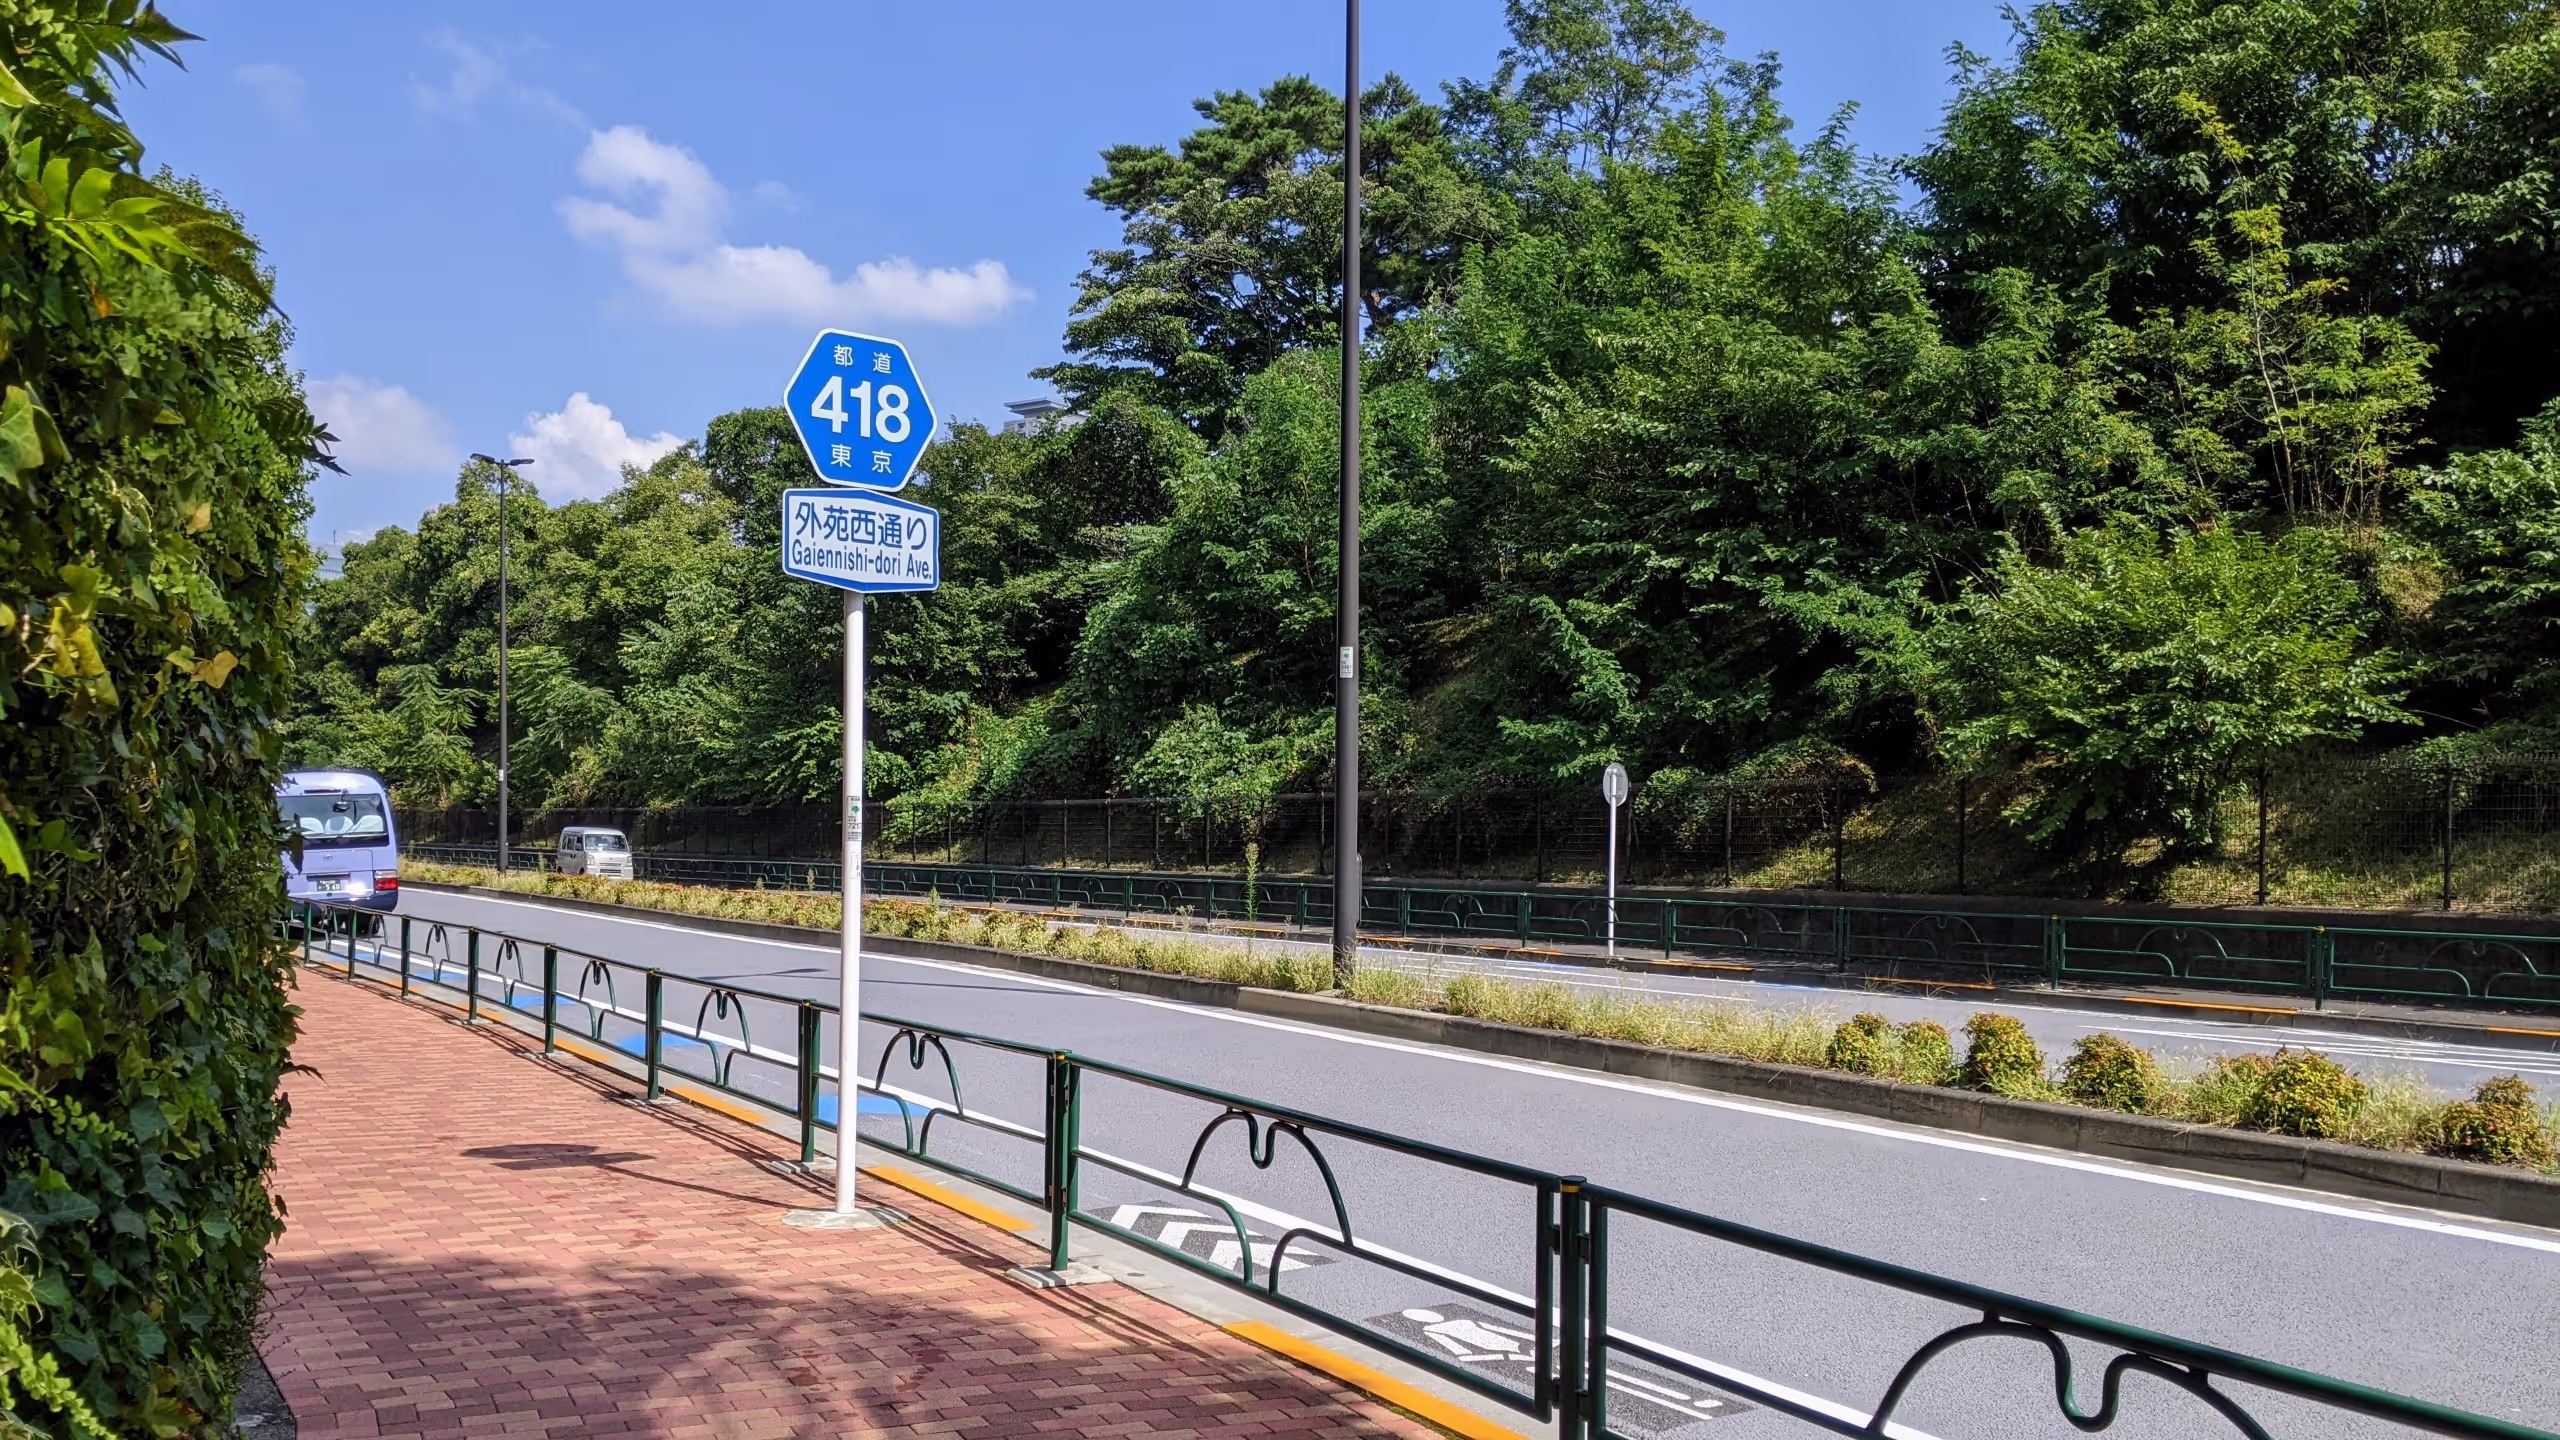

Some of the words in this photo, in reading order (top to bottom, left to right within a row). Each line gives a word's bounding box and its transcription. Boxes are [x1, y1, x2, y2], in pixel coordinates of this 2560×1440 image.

[833, 344, 892, 374] 都道
[811, 375, 911, 443] 418
[830, 443, 892, 474] 東京
[794, 501, 927, 551] 外苑西通り
[792, 538, 901, 577] Gaiennishi-dori
[906, 552, 932, 580] Ave.
